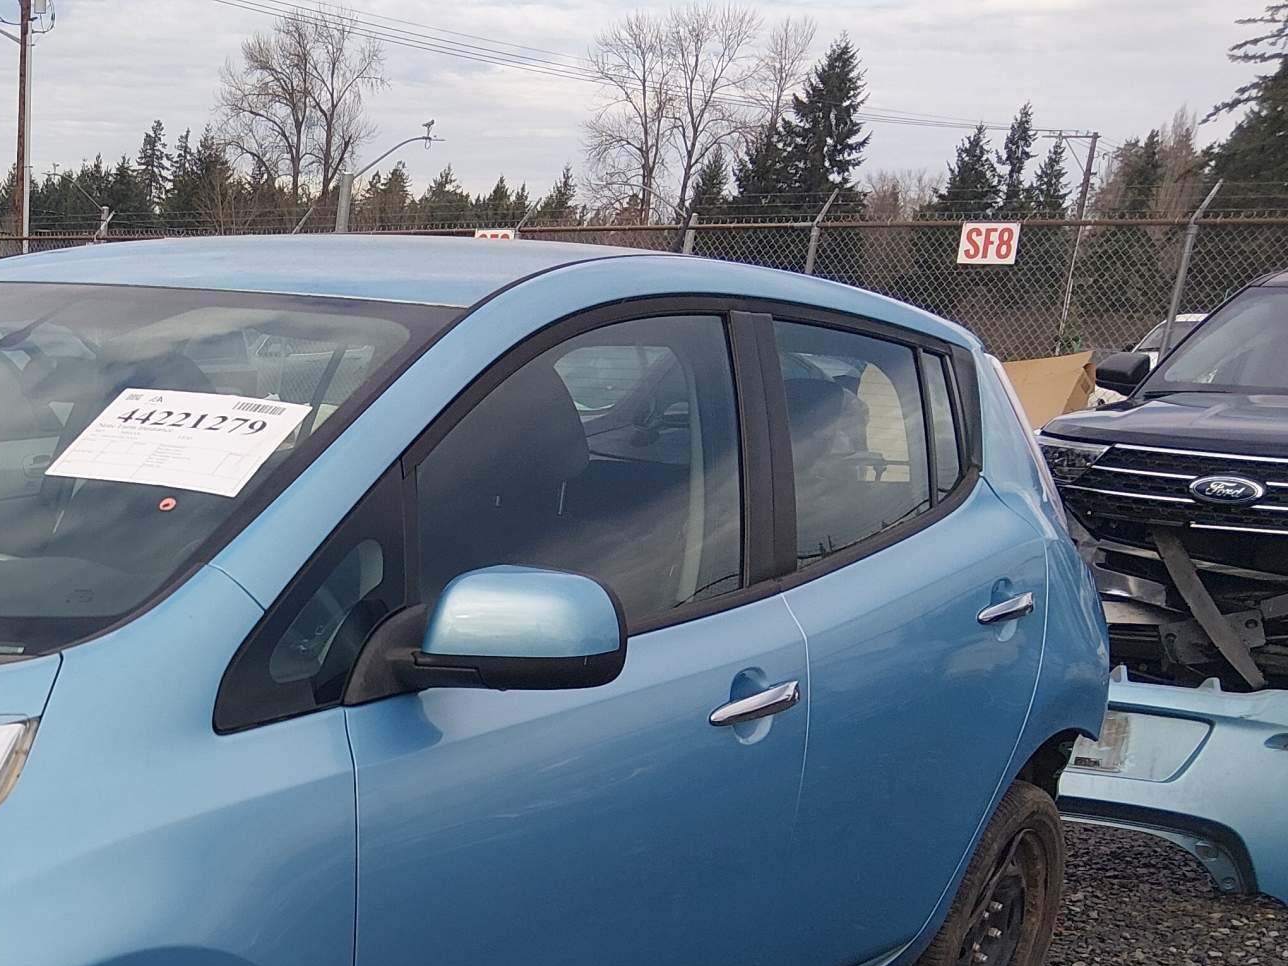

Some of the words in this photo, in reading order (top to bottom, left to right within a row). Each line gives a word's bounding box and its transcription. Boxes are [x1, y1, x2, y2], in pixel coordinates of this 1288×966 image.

[963, 227, 1014, 260] SF8
[117, 407, 267, 435] 44221279
[1205, 481, 1245, 498] Ford
